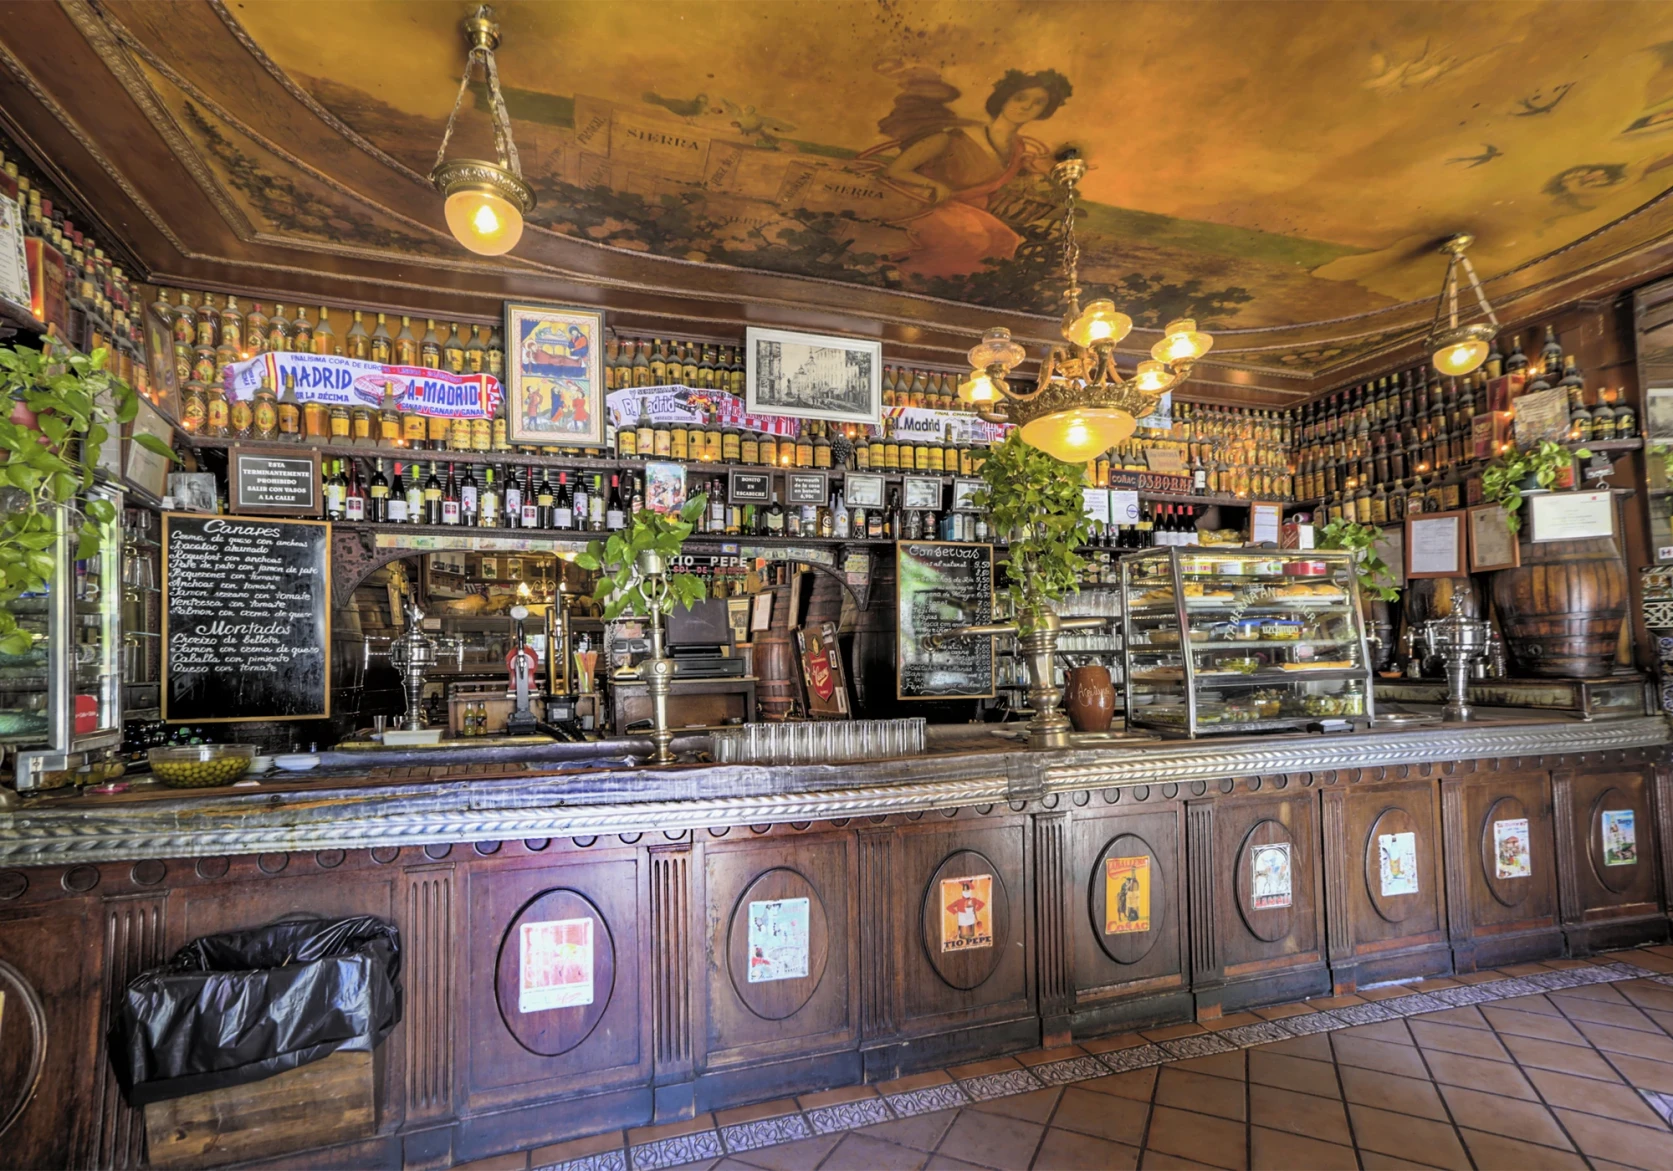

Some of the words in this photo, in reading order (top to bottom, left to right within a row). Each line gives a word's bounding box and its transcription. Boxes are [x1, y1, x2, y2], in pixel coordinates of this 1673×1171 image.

[627, 128, 699, 150] SIERRA
[824, 184, 885, 199] SIERRA
[328, 357, 350, 366] COPA
[280, 365, 352, 390] MADRID
[318, 392, 350, 402] DÉCIMA
[422, 380, 478, 406] MADRID
[430, 406, 454, 416] GANAR
[242, 469, 310, 478] TERMINANTEMENTE
[1112, 474, 1136, 485] COÑAC
[1138, 474, 1192, 492] OSBORNE
[204, 520, 280, 538] Canapes
[170, 540, 218, 552] Bacalao
[224, 545, 270, 554] ahumado
[210, 534, 224, 542] de
[228, 536, 252, 545] queso
[276, 539, 308, 548] anchoas
[169, 550, 222, 562] Roquefort
[245, 556, 282, 564] anchoas
[909, 544, 980, 559] Conservas
[214, 562, 235, 571] pato
[710, 556, 748, 568] PEPE
[168, 577, 214, 588] Anchoas
[244, 582, 276, 590] tomate
[275, 592, 311, 600] tomate
[250, 600, 286, 608] tomate
[1224, 591, 1259, 640] TABERNA
[196, 620, 291, 636] Montados
[172, 633, 218, 644] Chorizo
[223, 635, 238, 644] de
[243, 635, 280, 644] bellota
[172, 653, 220, 662] Caballa
[248, 655, 290, 665] pimiento
[172, 663, 209, 672] Queso
[240, 664, 278, 672] tomate
[944, 940, 964, 948] TIO
[966, 936, 992, 945] PEPE
